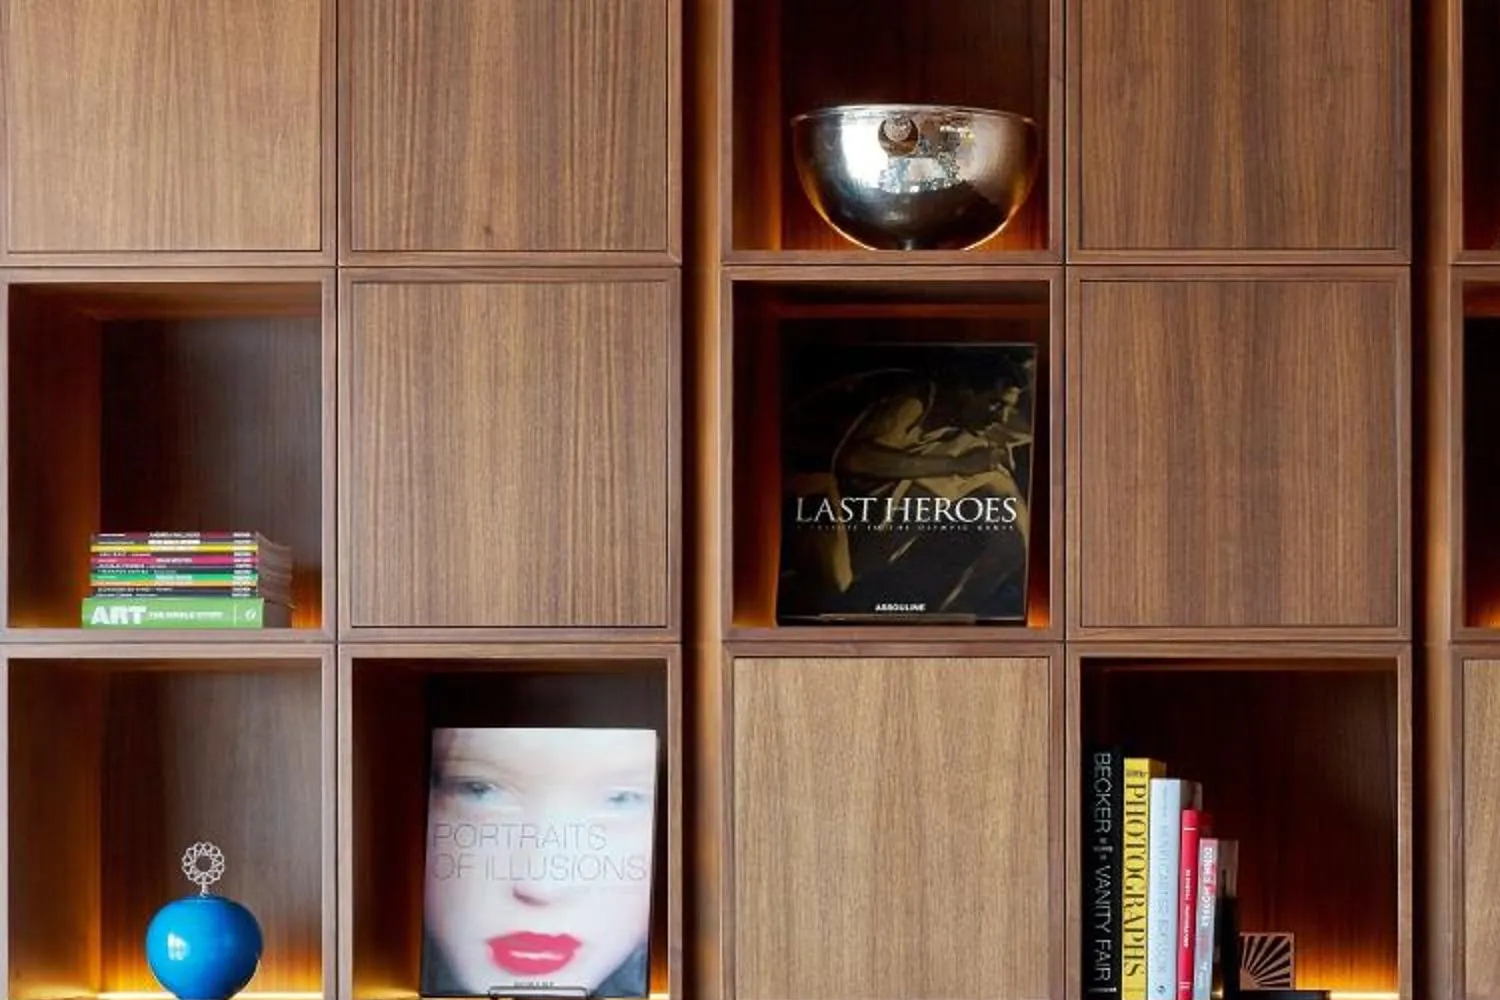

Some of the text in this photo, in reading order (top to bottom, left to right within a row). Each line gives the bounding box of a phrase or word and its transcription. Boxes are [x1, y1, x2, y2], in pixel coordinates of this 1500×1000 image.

[795, 496, 1018, 524] LAST HEROES
[90, 605, 147, 625] ART
[432, 822, 608, 850] PORTRAITS
[430, 852, 647, 882] OF ILLUSIONS
[1094, 752, 1112, 981] BECKER VANITY FAIR
[1124, 783, 1146, 977] PHOTOGRAPHS
